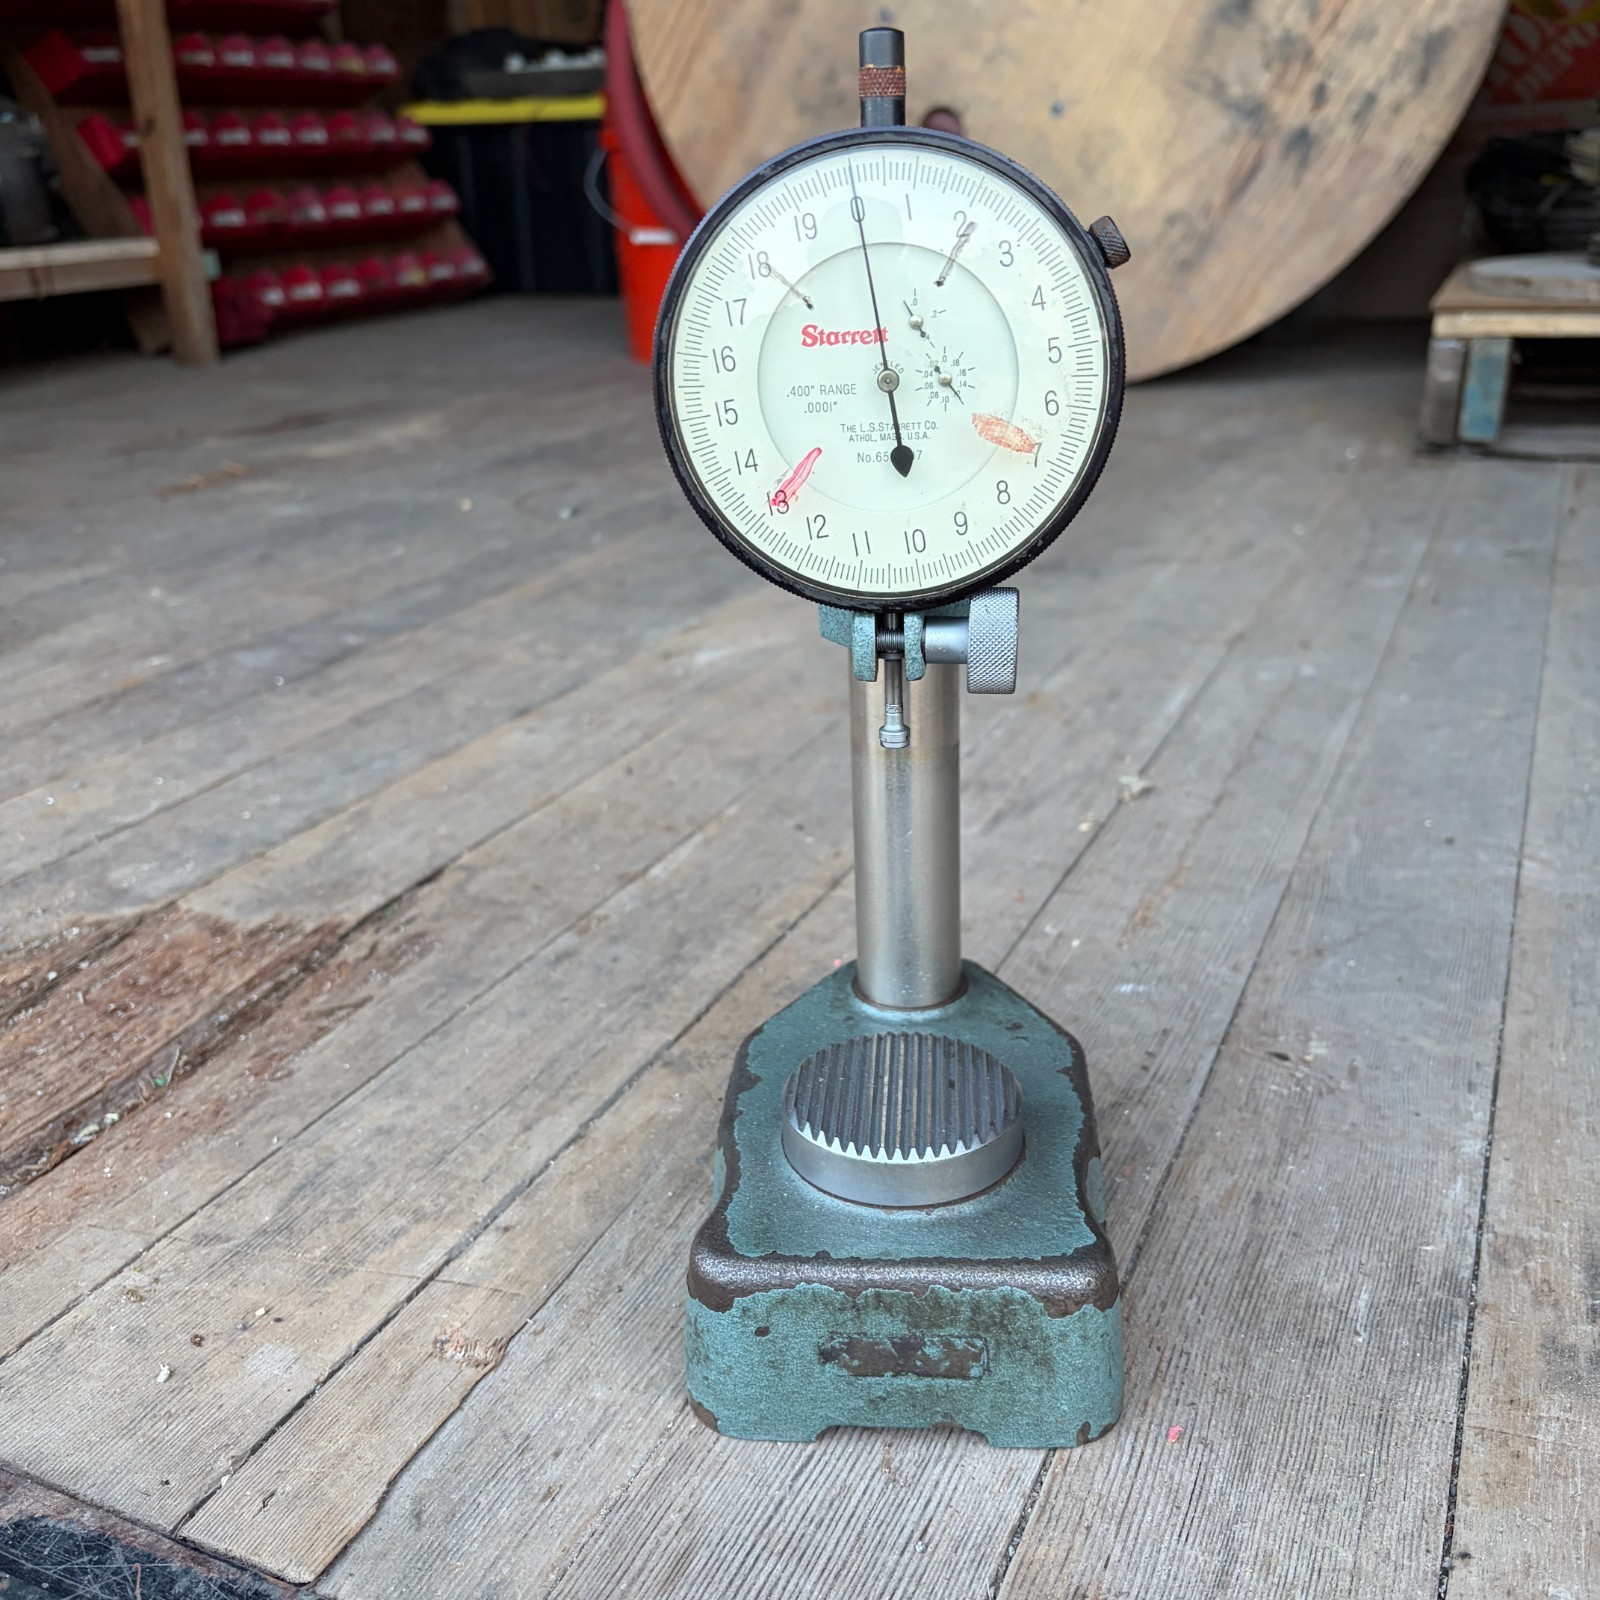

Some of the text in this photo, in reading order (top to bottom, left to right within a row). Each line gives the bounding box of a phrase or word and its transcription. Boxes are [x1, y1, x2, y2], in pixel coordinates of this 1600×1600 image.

[850, 195, 866, 224] 0
[905, 194, 913, 221] 1
[793, 211, 818, 242] 19
[953, 210, 971, 238] 2
[747, 250, 771, 279] 18
[998, 239, 1015, 267] 3
[1031, 284, 1048, 311] 4
[725, 298, 748, 326] 17
[801, 324, 889, 348] Starrett
[712, 345, 736, 374] 16
[1047, 336, 1062, 364] 5
[786, 384, 857, 397] .400" RANGE
[1044, 390, 1060, 416] 6
[714, 398, 739, 427] 15
[848, 431, 931, 442] ATHOL, MAS. U.S.A.
[859, 421, 922, 433] L.S.STARETT
[736, 448, 759, 475] 14
[1031, 441, 1043, 467] 7
[768, 489, 790, 516] 13
[996, 480, 1011, 506] 8
[806, 514, 830, 541] 12
[954, 510, 968, 536] 9
[852, 530, 872, 556] 11
[904, 528, 927, 554] 10
